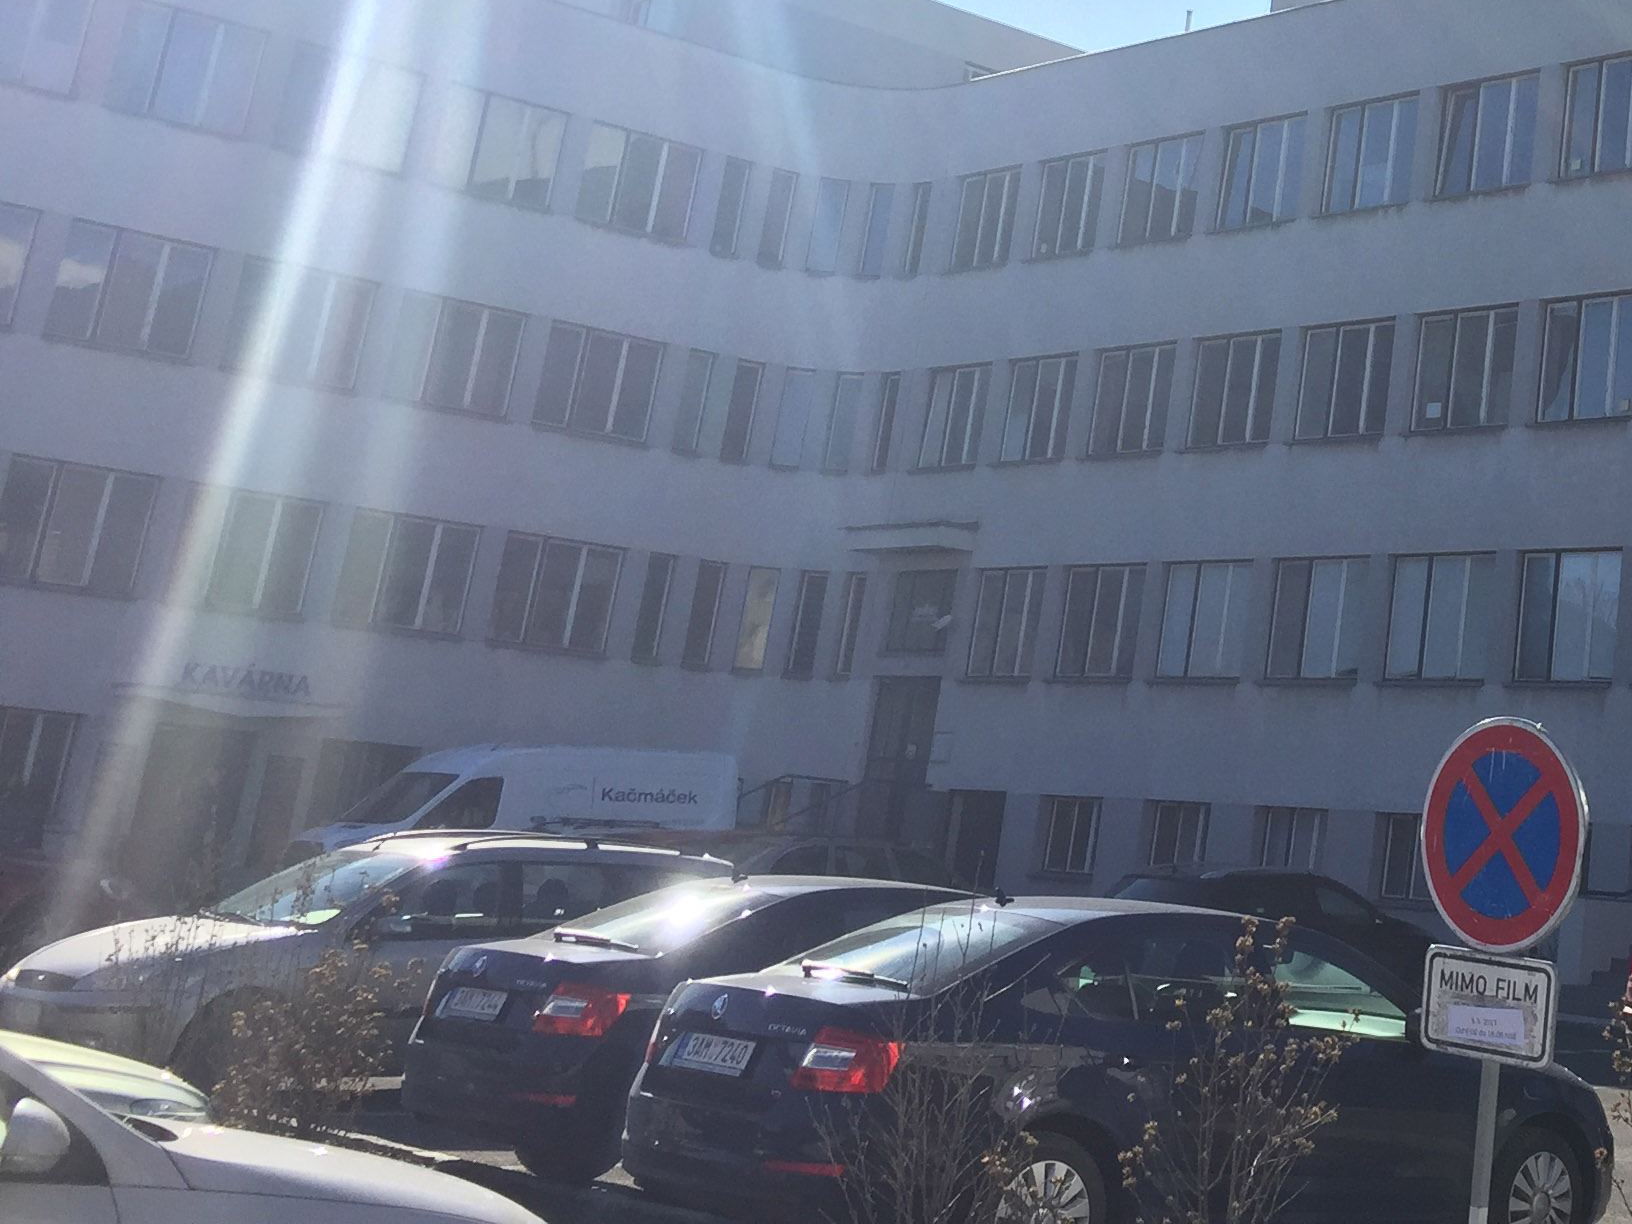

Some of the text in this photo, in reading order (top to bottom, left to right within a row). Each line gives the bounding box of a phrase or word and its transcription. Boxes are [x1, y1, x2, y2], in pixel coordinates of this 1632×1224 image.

[182, 662, 311, 698] KAVÁRNA
[601, 788, 698, 805] Kačmáček
[1440, 969, 1539, 1004] MIMO FILM
